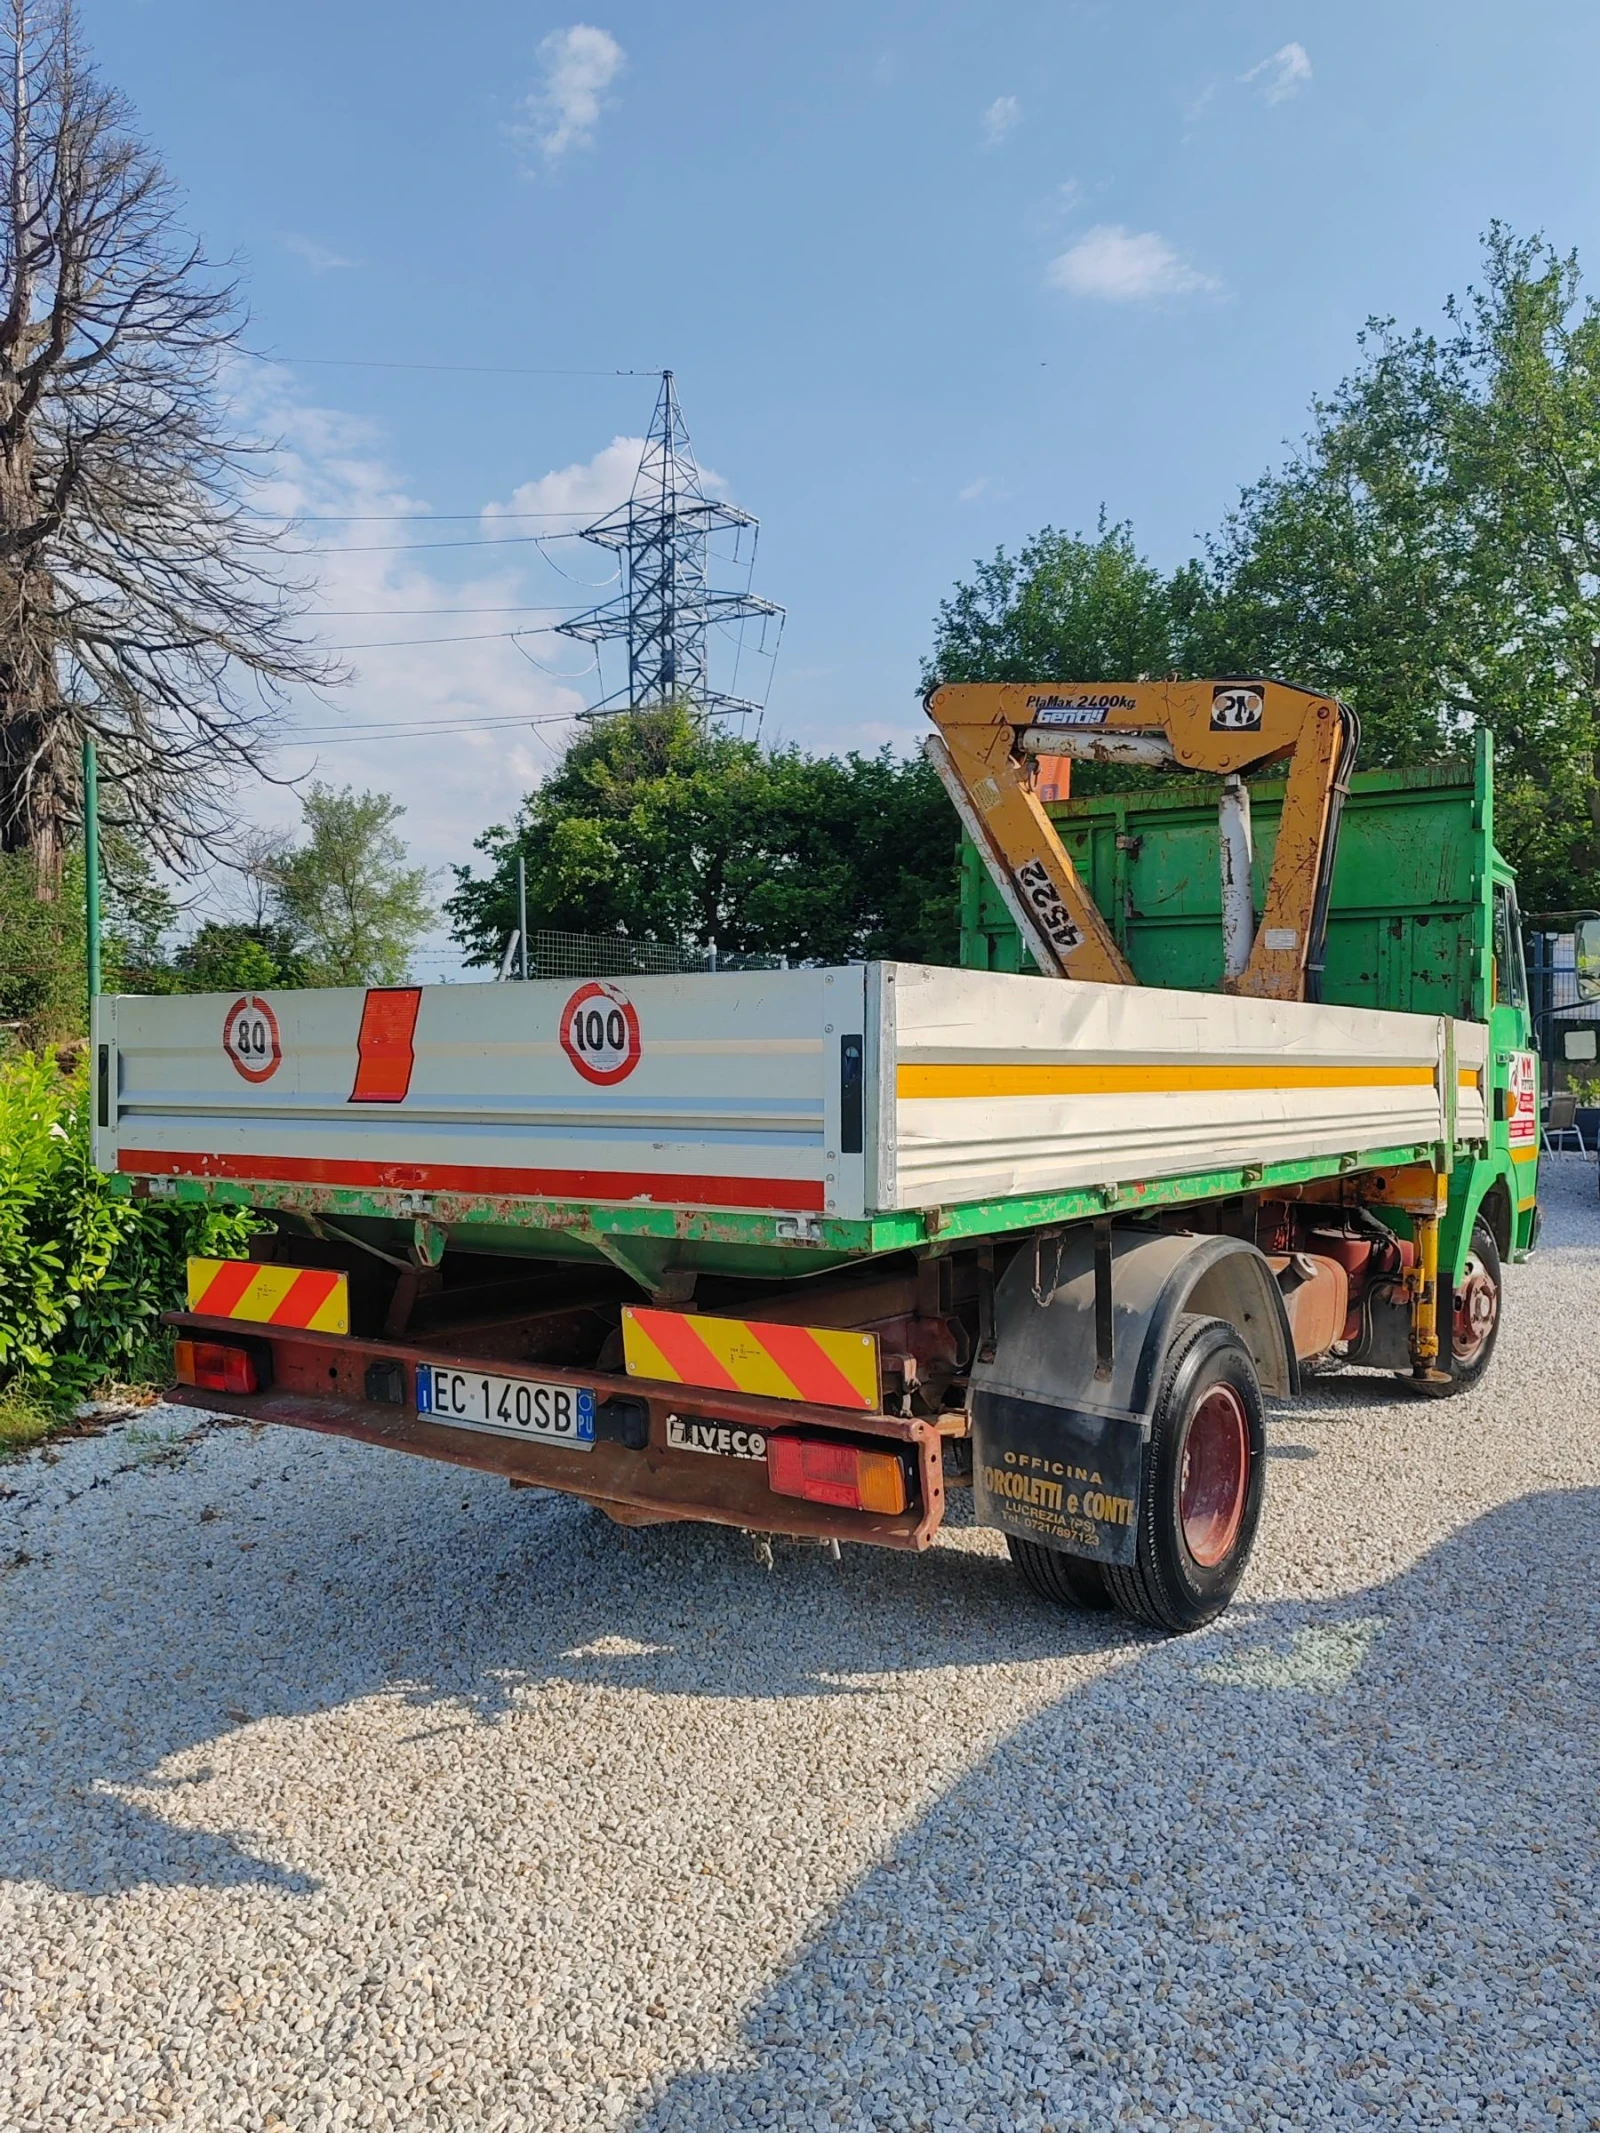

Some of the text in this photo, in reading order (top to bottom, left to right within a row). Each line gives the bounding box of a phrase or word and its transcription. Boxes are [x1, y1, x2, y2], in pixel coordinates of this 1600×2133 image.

[1021, 861, 1078, 946] 4522
[238, 1020, 265, 1054] 80
[573, 1009, 625, 1051] 100
[578, 1414, 593, 1434] PU
[691, 1424, 767, 1456] IVECO
[1003, 1451, 1103, 1485] OFFICINA
[1005, 1501, 1096, 1534] LUCREZIA (PS)
[1066, 1493, 1079, 1514] e
[1001, 1510, 1100, 1546] Tel. 0721/897123
